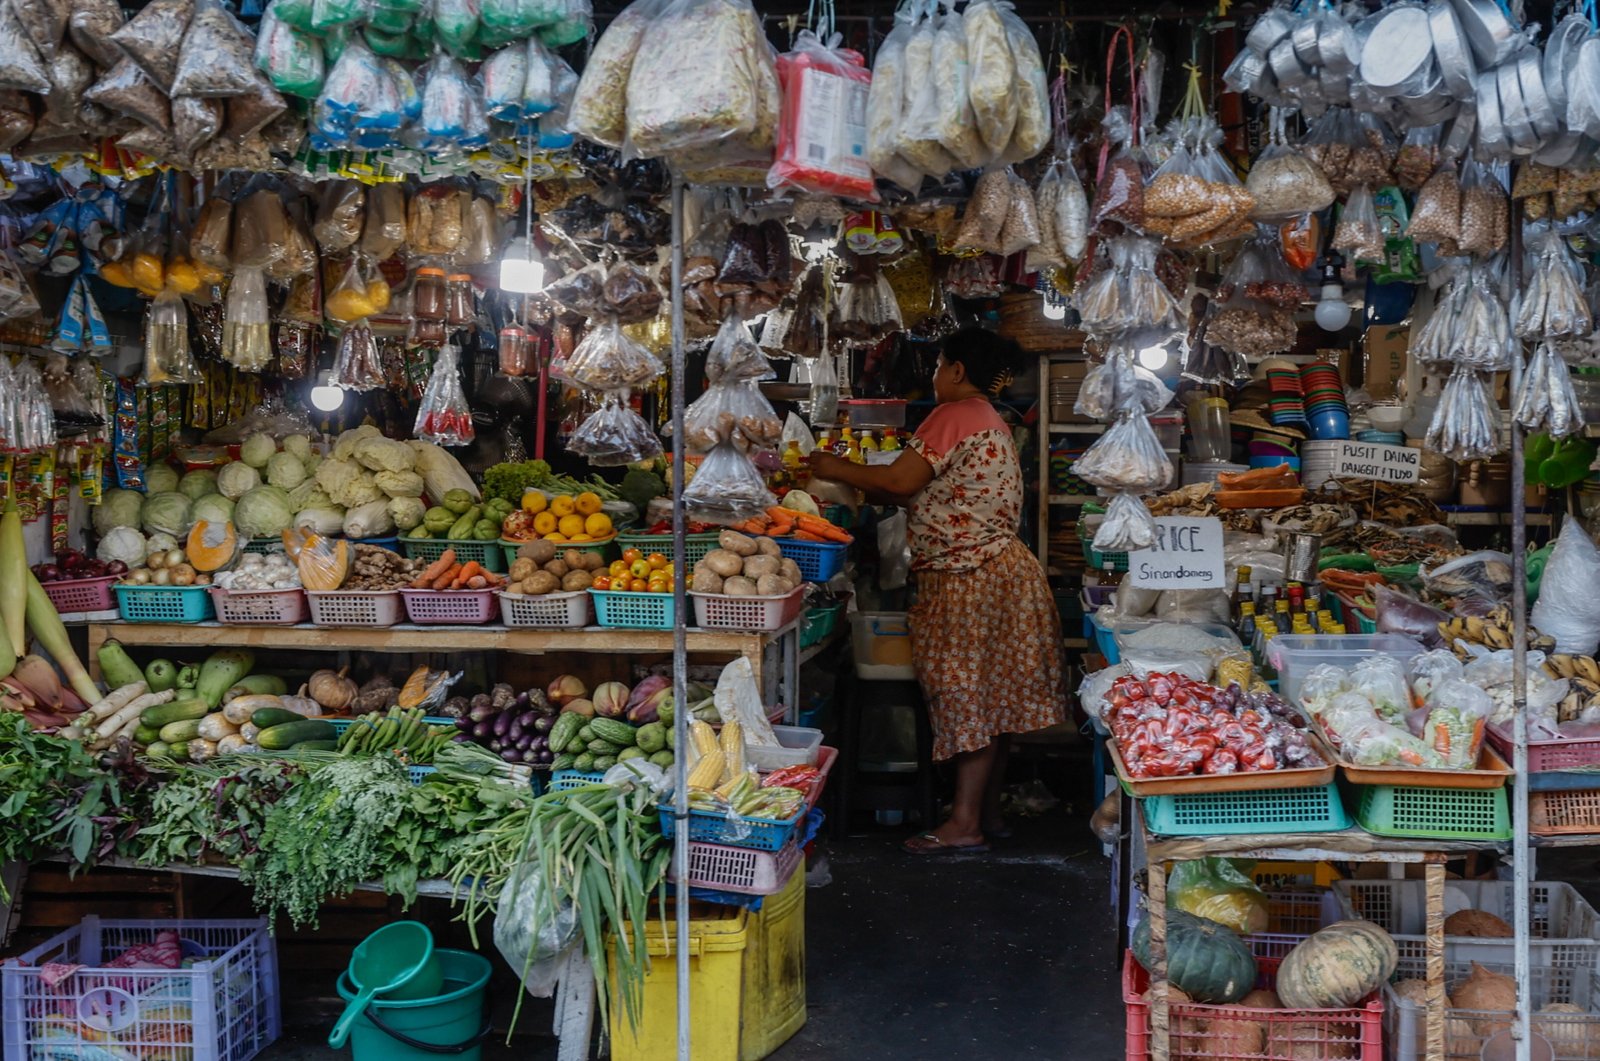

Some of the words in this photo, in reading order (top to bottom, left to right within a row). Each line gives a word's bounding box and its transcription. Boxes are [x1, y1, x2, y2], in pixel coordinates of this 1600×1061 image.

[1390, 351, 1400, 370] UP
[1343, 445, 1377, 459] PUSIT
[1384, 449, 1417, 464] DAING
[1341, 462, 1379, 476] DANGGIT
[1389, 468, 1413, 480] TUYO
[1139, 563, 1213, 582] Sinandomeng
